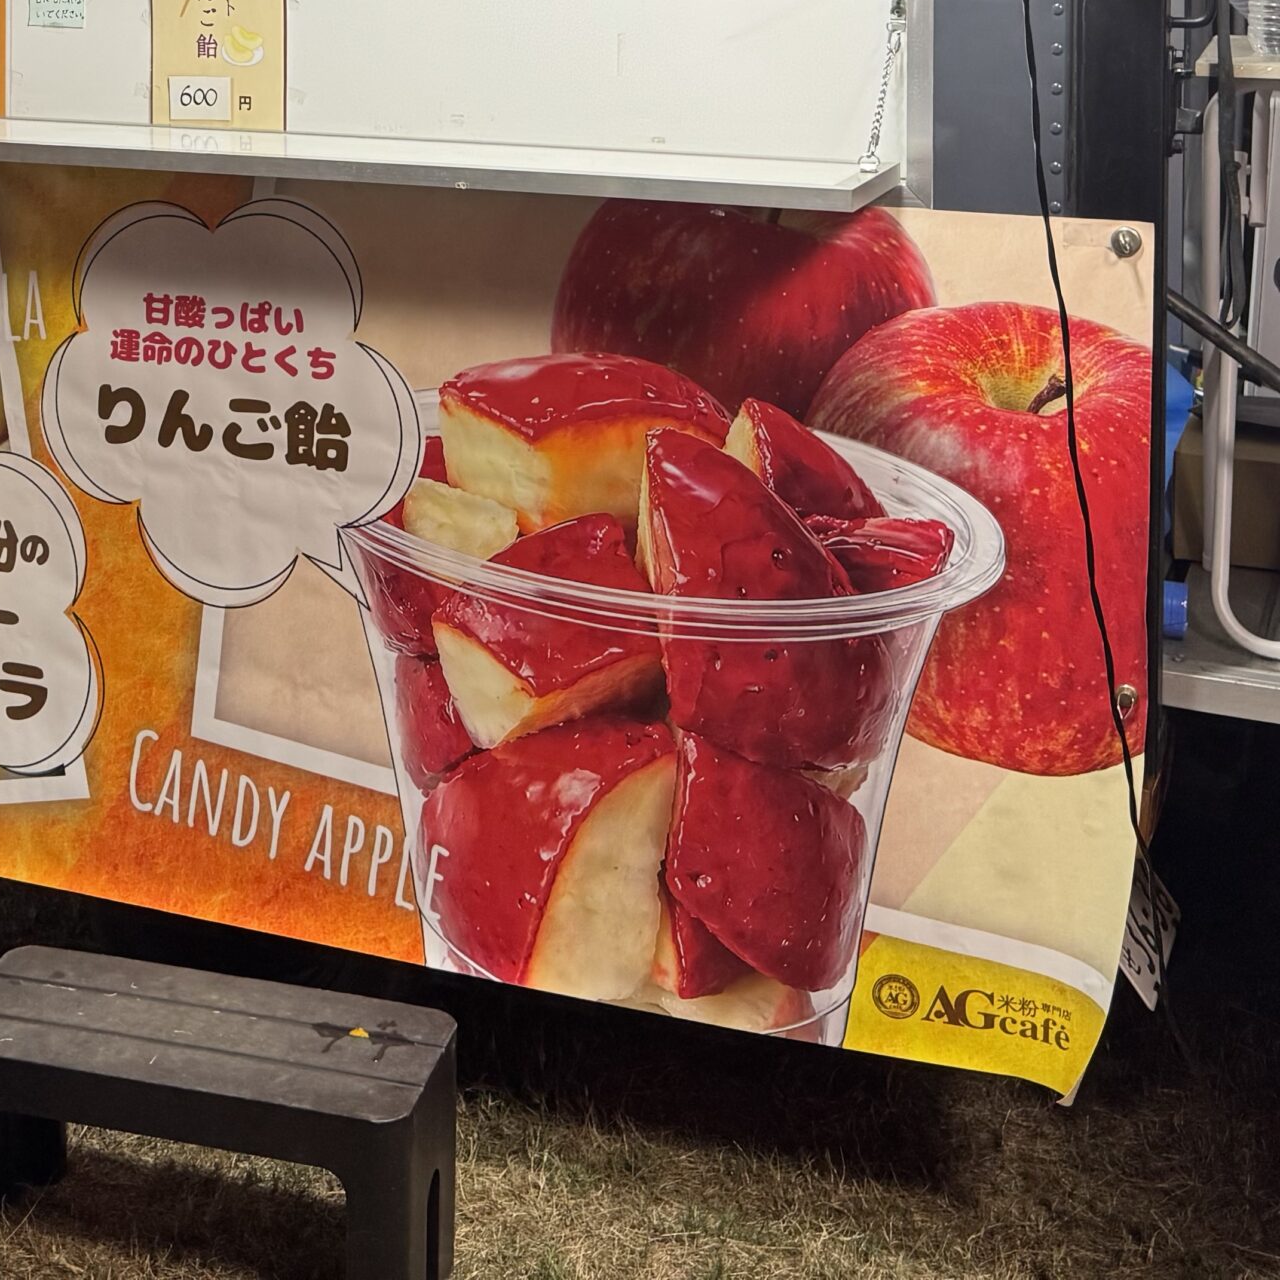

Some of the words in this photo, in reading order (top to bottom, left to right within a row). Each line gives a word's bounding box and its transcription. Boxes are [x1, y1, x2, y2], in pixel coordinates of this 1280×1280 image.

[179, 84, 218, 107] 600
[238, 95, 252, 111] 円
[143, 293, 304, 335] 甘酸っぱい
[110, 328, 337, 380] 運命のひとくち
[98, 383, 352, 472] りんご飴
[129, 730, 290, 859] CANDY
[304, 804, 450, 920] APPLE
